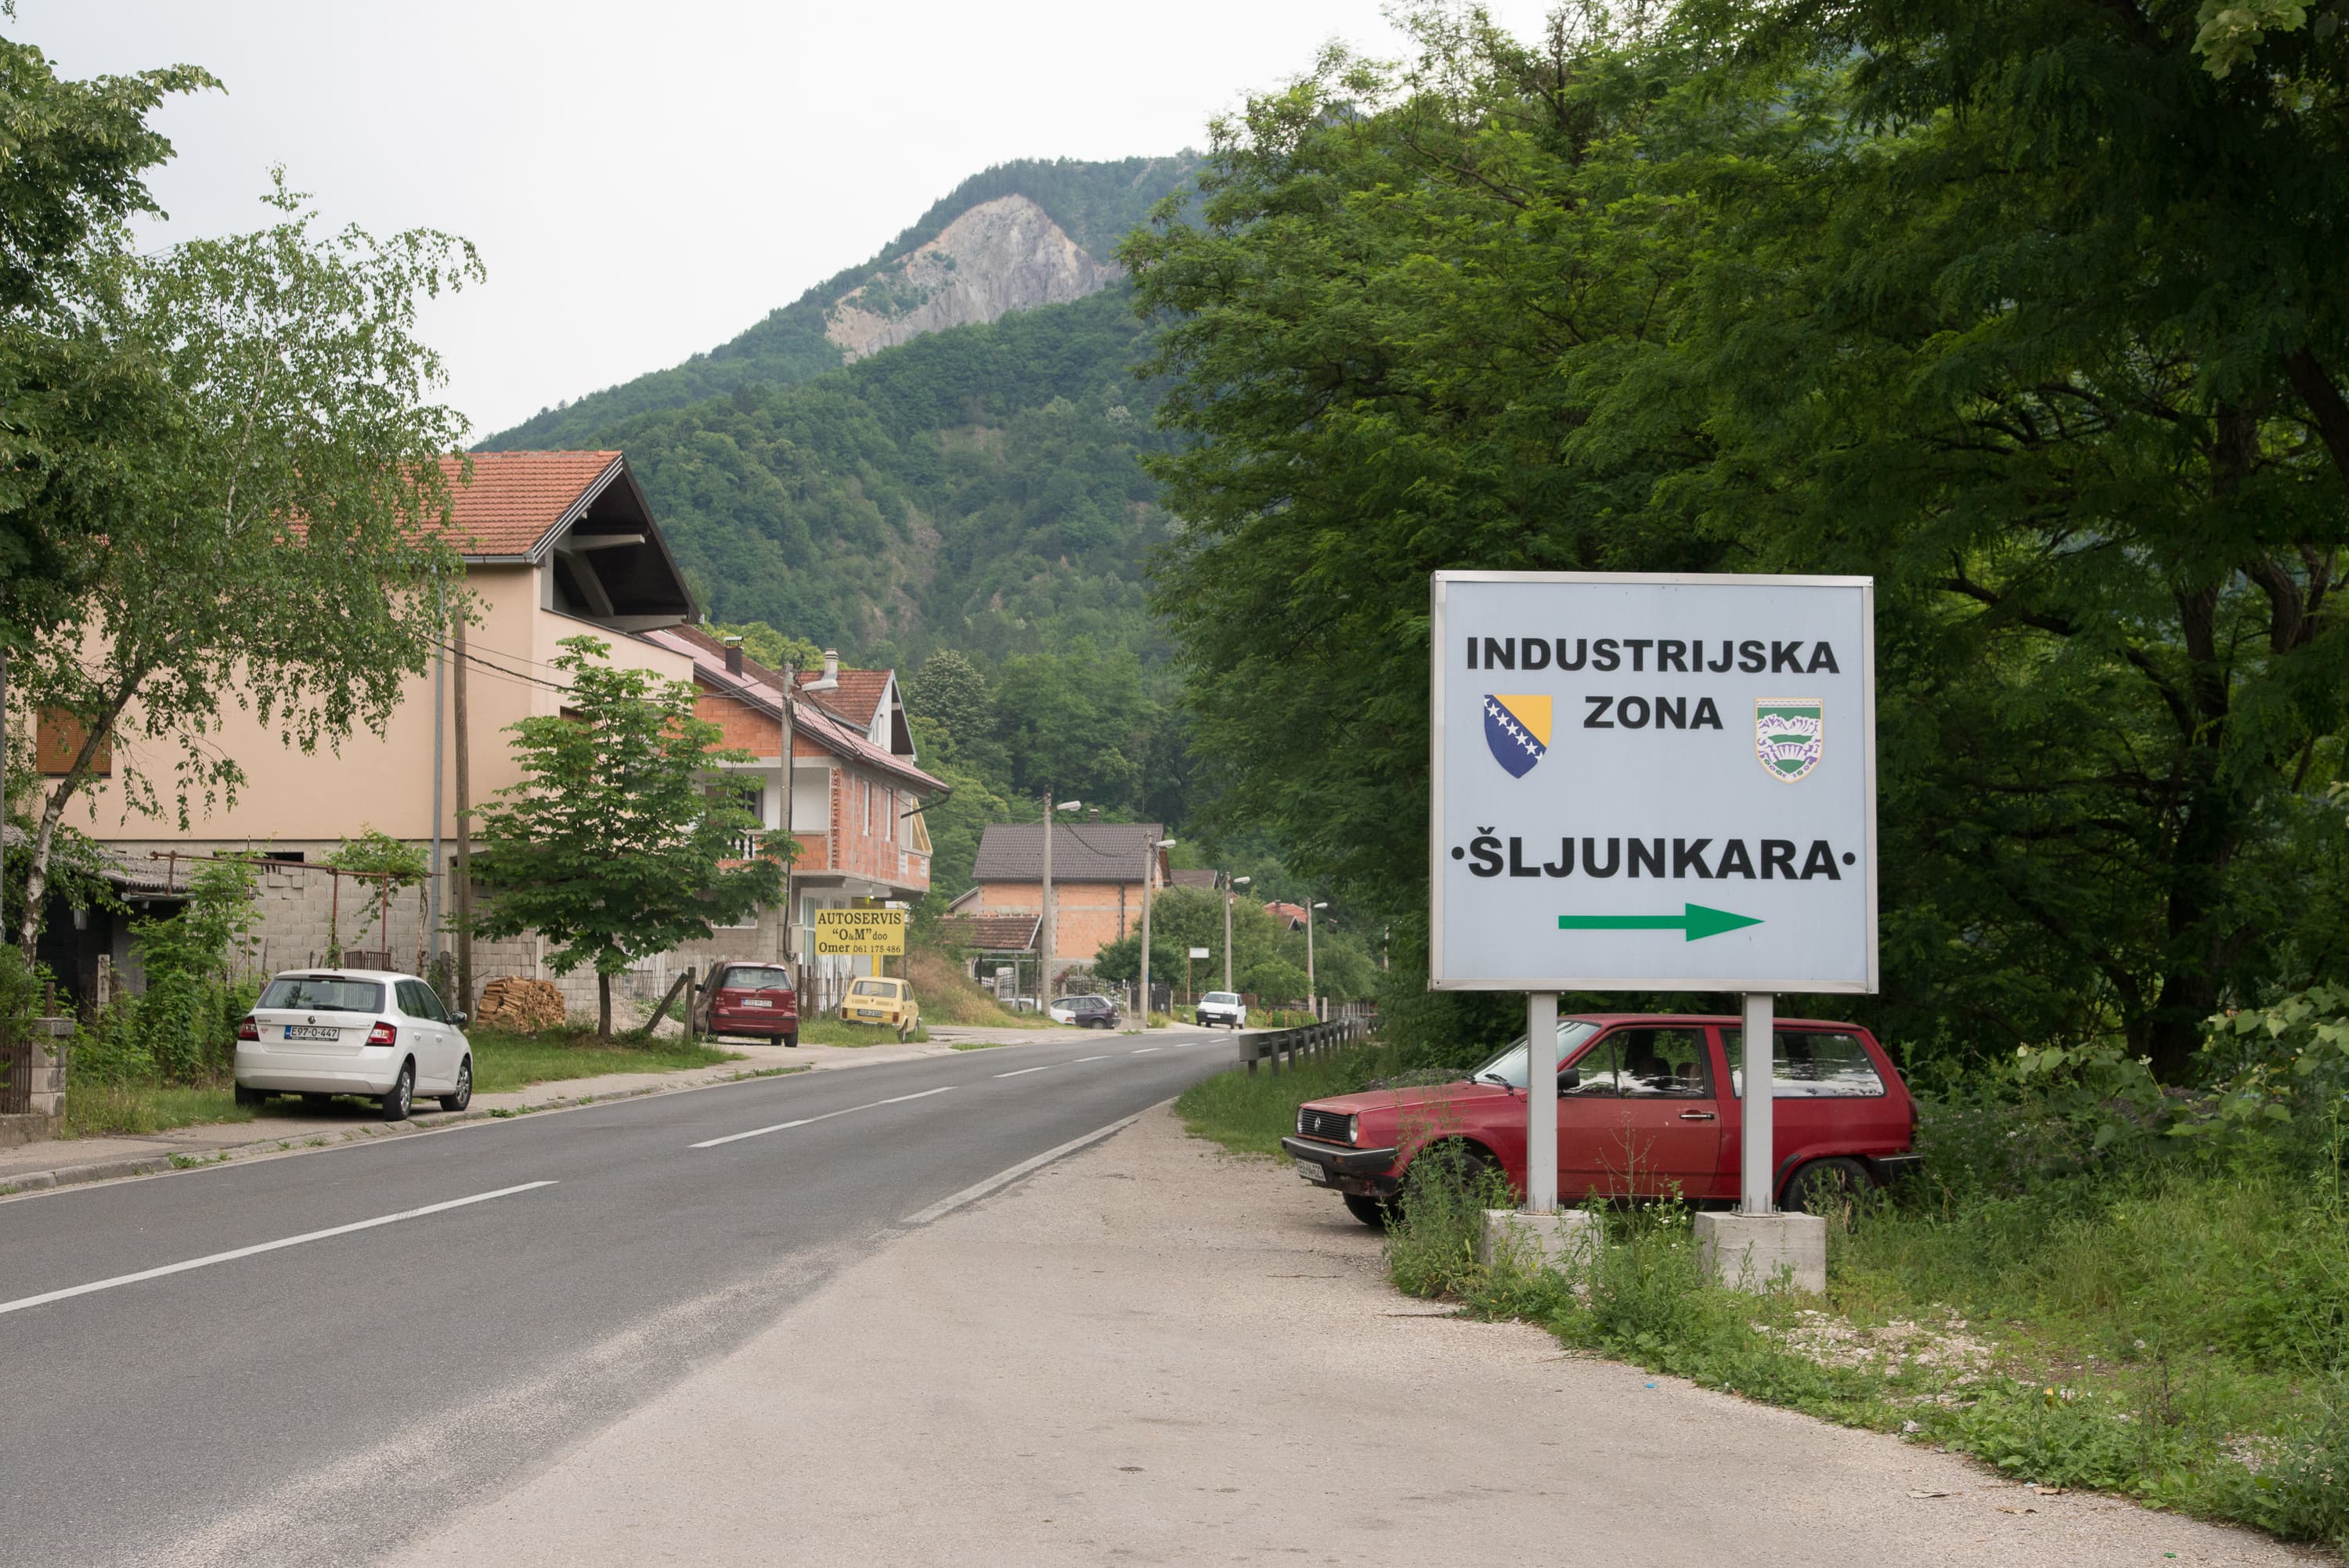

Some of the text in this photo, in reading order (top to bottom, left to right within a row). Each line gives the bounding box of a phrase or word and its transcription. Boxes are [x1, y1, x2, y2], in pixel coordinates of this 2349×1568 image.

[1467, 636, 1841, 674] INDUSTRIJSKA
[1583, 695, 1724, 730] ZONA
[817, 912, 901, 925] AUTOSERVIS
[872, 931, 888, 940] doo
[818, 942, 850, 953] Omer
